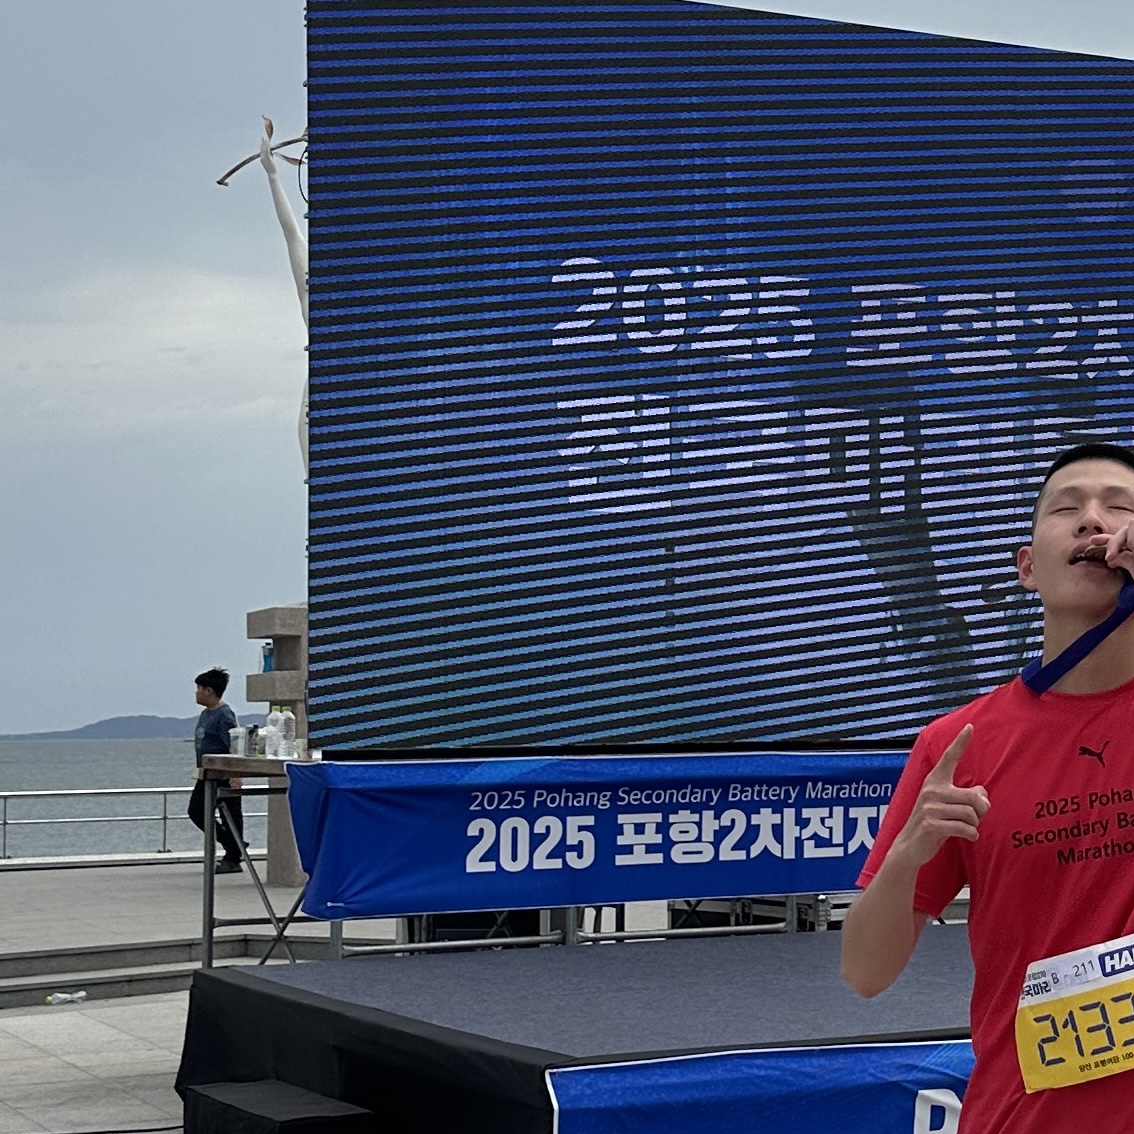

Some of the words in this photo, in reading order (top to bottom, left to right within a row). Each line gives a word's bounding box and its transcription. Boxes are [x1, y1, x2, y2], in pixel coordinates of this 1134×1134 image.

[551, 255, 816, 362] 2025
[469, 790, 526, 811] 2025
[533, 788, 612, 809] Pohang
[616, 784, 722, 806] Secondary
[728, 783, 800, 804] Battery
[805, 780, 893, 799] Marathon
[1035, 795, 1081, 819] 2025
[466, 815, 595, 873] 2025
[615, 804, 889, 866] 포항2차전지
[1011, 818, 1110, 849] Secondary
[1072, 959, 1095, 978] 211
